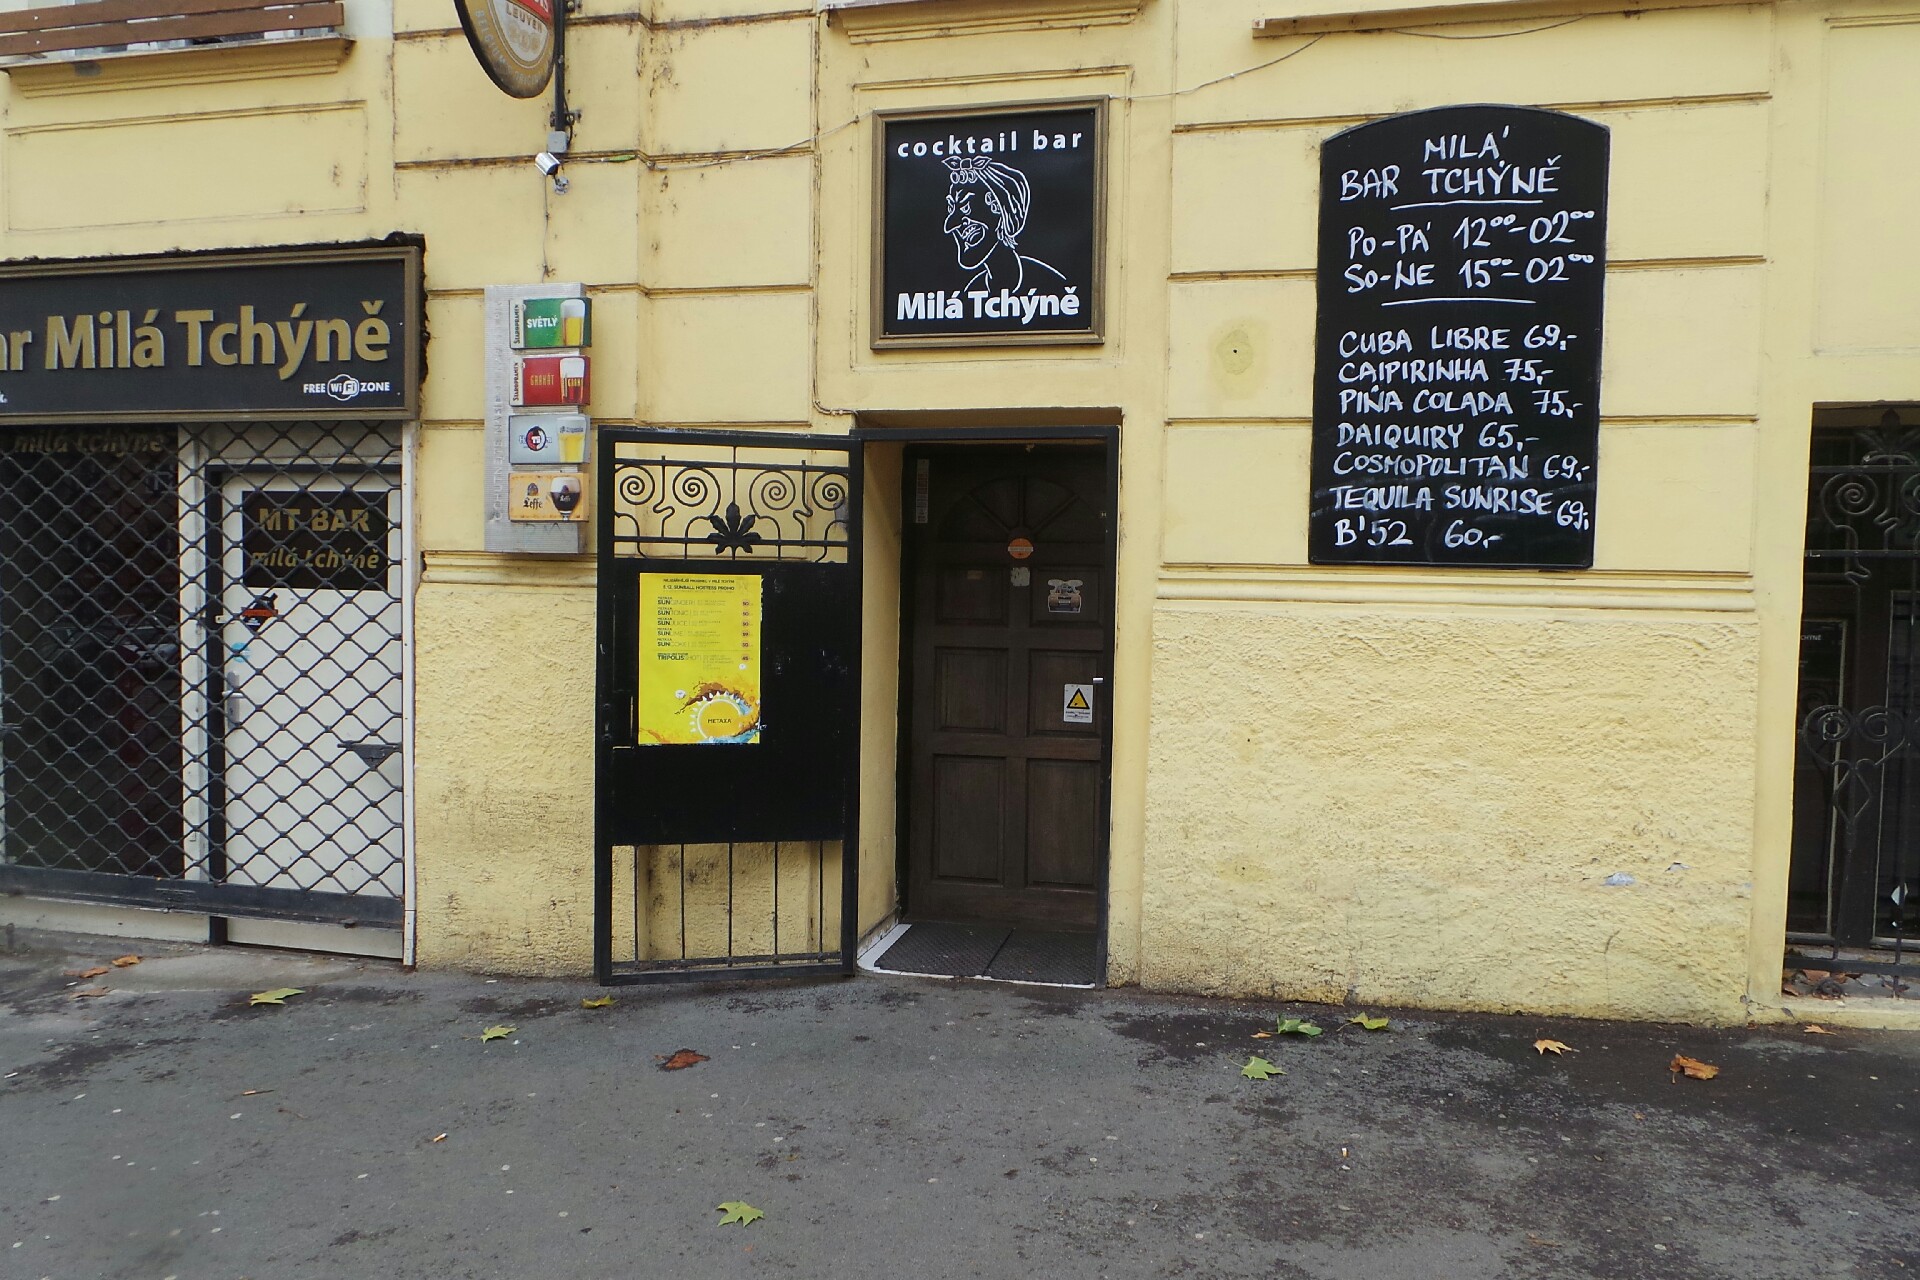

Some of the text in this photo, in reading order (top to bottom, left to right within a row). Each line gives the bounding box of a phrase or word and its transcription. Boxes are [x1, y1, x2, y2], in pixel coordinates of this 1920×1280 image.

[897, 129, 1083, 158] cocktail bar
[1424, 125, 1510, 163] MILÁ
[1339, 164, 1400, 202] BAR
[897, 286, 1080, 325] Milá Tchýně
[527, 315, 558, 329] SVĚTLÝ
[0, 299, 392, 382] r Milá Tchýně
[1338, 328, 1414, 358] CUBA
[1431, 325, 1511, 352] LIBRE
[1338, 359, 1489, 384] CAIPIRINHA
[303, 383, 326, 394] FREE
[360, 382, 390, 392] ZONE
[1412, 388, 1514, 417] COLADA
[1336, 422, 1465, 450] DAIQUIRY
[1333, 451, 1530, 480] COSMOPOLITAN
[523, 497, 543, 510] Leffe
[1329, 485, 1435, 511] TEQUILA
[1444, 485, 1554, 516] SUNRISE
[259, 507, 370, 532] MT BAR
[250, 547, 299, 567] milá
